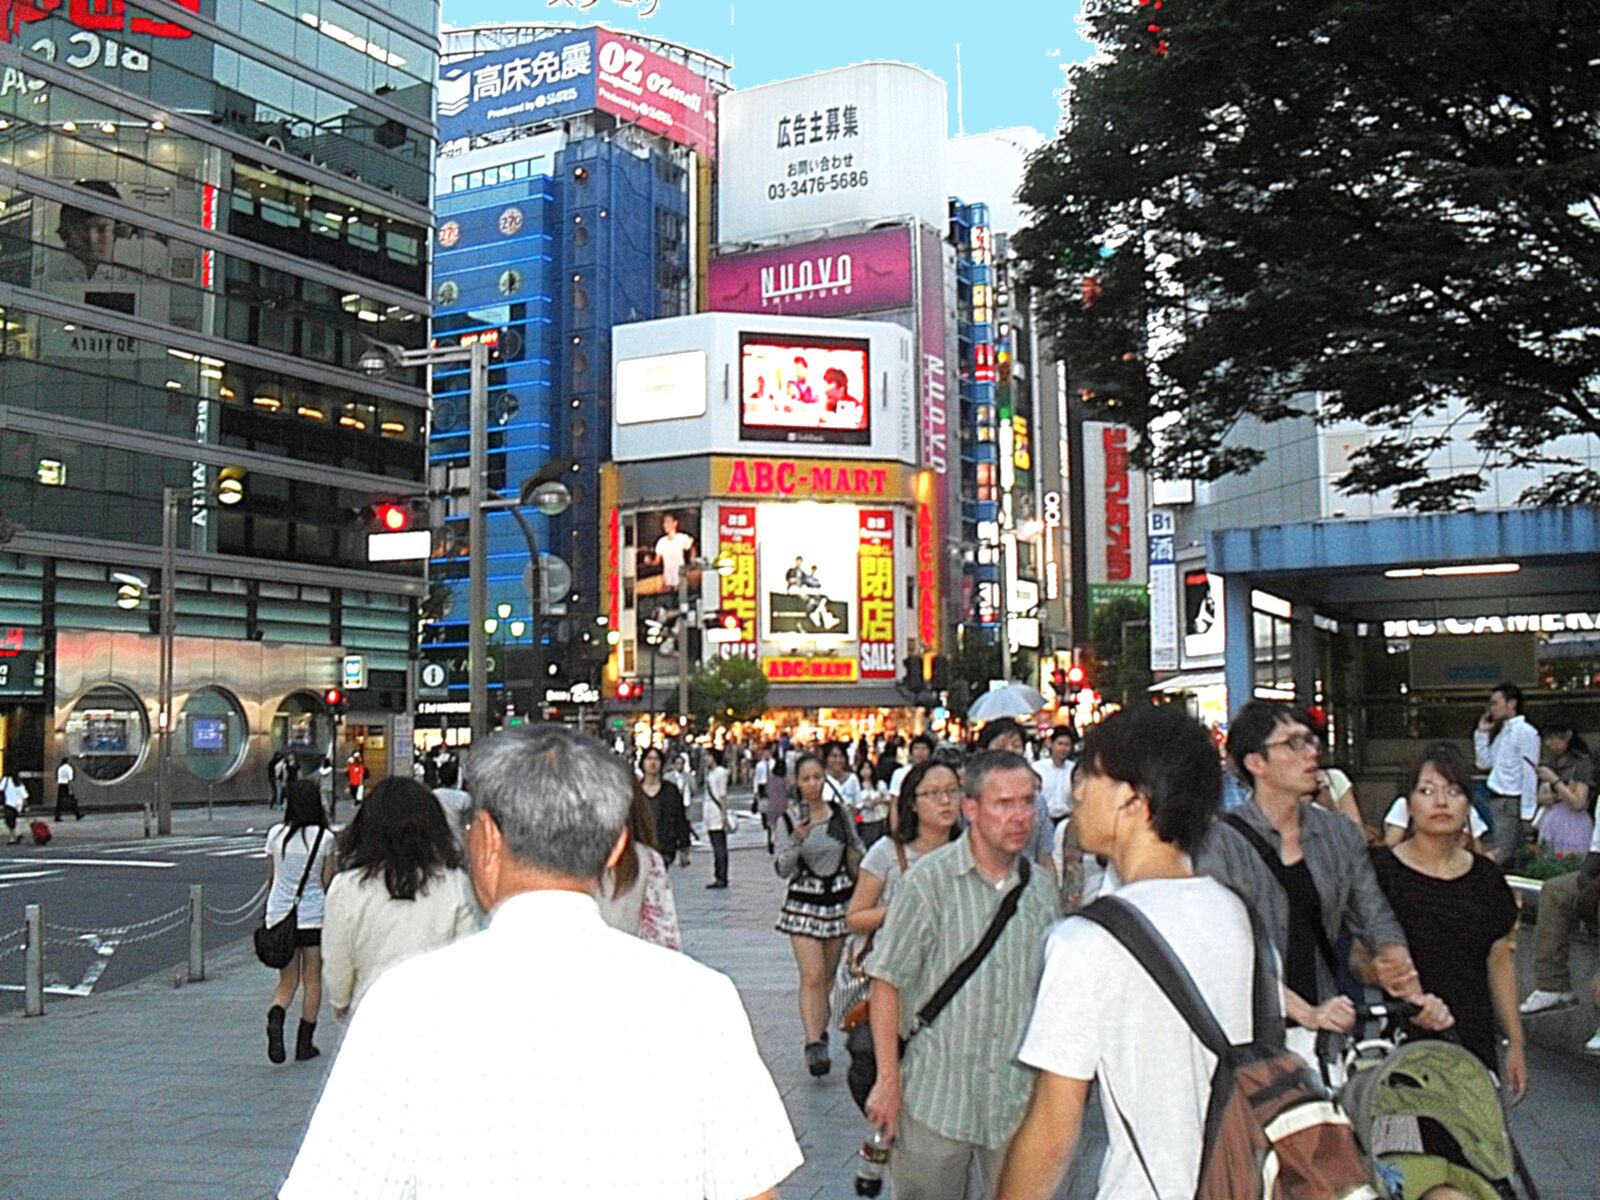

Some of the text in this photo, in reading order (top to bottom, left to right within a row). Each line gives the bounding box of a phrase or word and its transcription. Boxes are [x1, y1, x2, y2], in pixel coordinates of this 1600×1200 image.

[473, 40, 591, 102] 高床免震
[599, 41, 645, 85] OZ
[777, 104, 860, 150] 広告主募集
[786, 153, 854, 178] お問い合わせ
[768, 170, 869, 201] 03-3476-5686
[760, 254, 852, 299] NUOVO
[728, 459, 888, 495] ABC-MART
[1152, 513, 1172, 531] B1
[860, 557, 894, 642] 閉店
[1444, 612, 1600, 634] CAMER
[767, 660, 853, 682] ABC-MART
[861, 642, 895, 672] SALE
